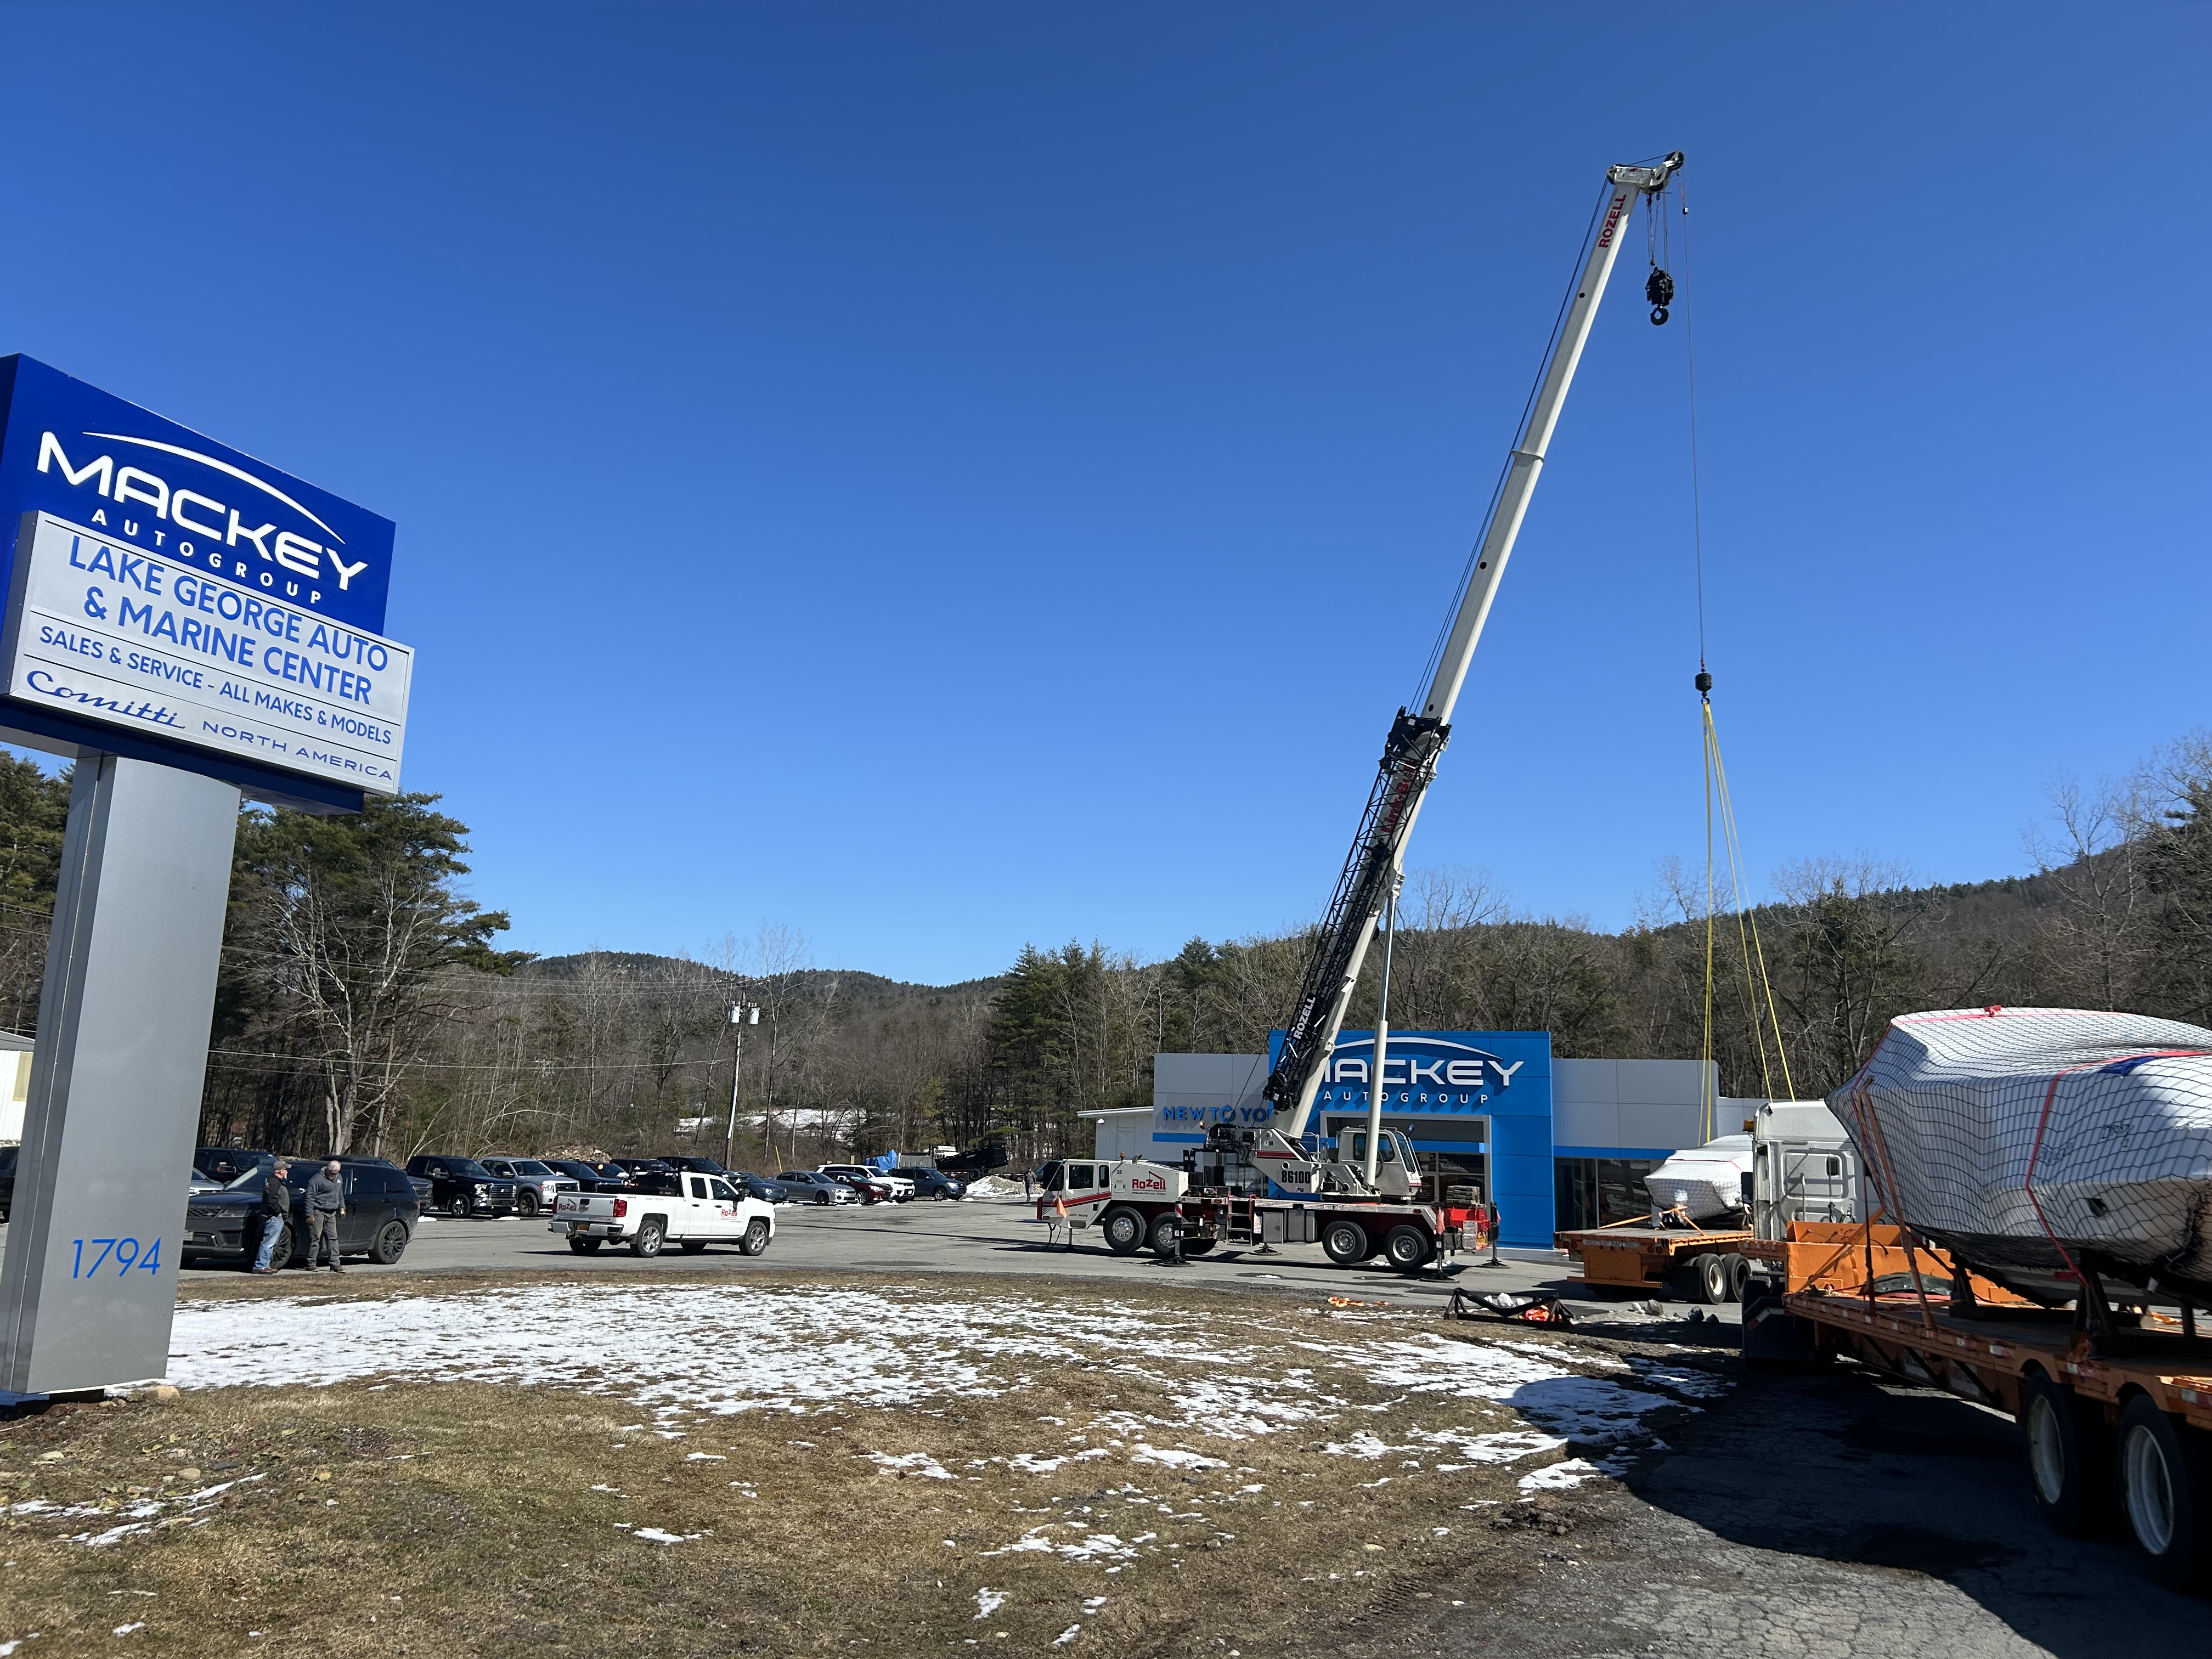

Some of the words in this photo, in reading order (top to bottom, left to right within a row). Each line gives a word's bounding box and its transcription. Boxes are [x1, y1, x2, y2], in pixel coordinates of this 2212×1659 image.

[1598, 194, 1627, 249] ROZELL
[37, 431, 369, 591] MACKEY
[91, 509, 321, 604] AUTOGROUP
[69, 535, 165, 596] LAKE
[173, 575, 302, 644] GEORGE
[307, 624, 388, 672] AUTO
[84, 586, 108, 620] &
[118, 596, 256, 668] MARINE
[263, 646, 372, 705] CENTER
[26, 670, 186, 729] Comitti
[202, 720, 287, 753] NORTH
[295, 747, 392, 781] AMERICA
[39, 625, 104, 659] SALES
[109, 646, 122, 664] &
[127, 652, 204, 689] SERVICE
[219, 681, 250, 703] ALL
[255, 690, 313, 721] MAKES
[317, 710, 327, 726] &
[330, 714, 392, 745] MODELS
[1293, 996, 1316, 1040] ROZELL
[1163, 1106, 1205, 1120] NEW
[1209, 1104, 1235, 1122] TO
[1282, 1170, 1311, 1184] 86100
[71, 1236, 161, 1279] 1794
